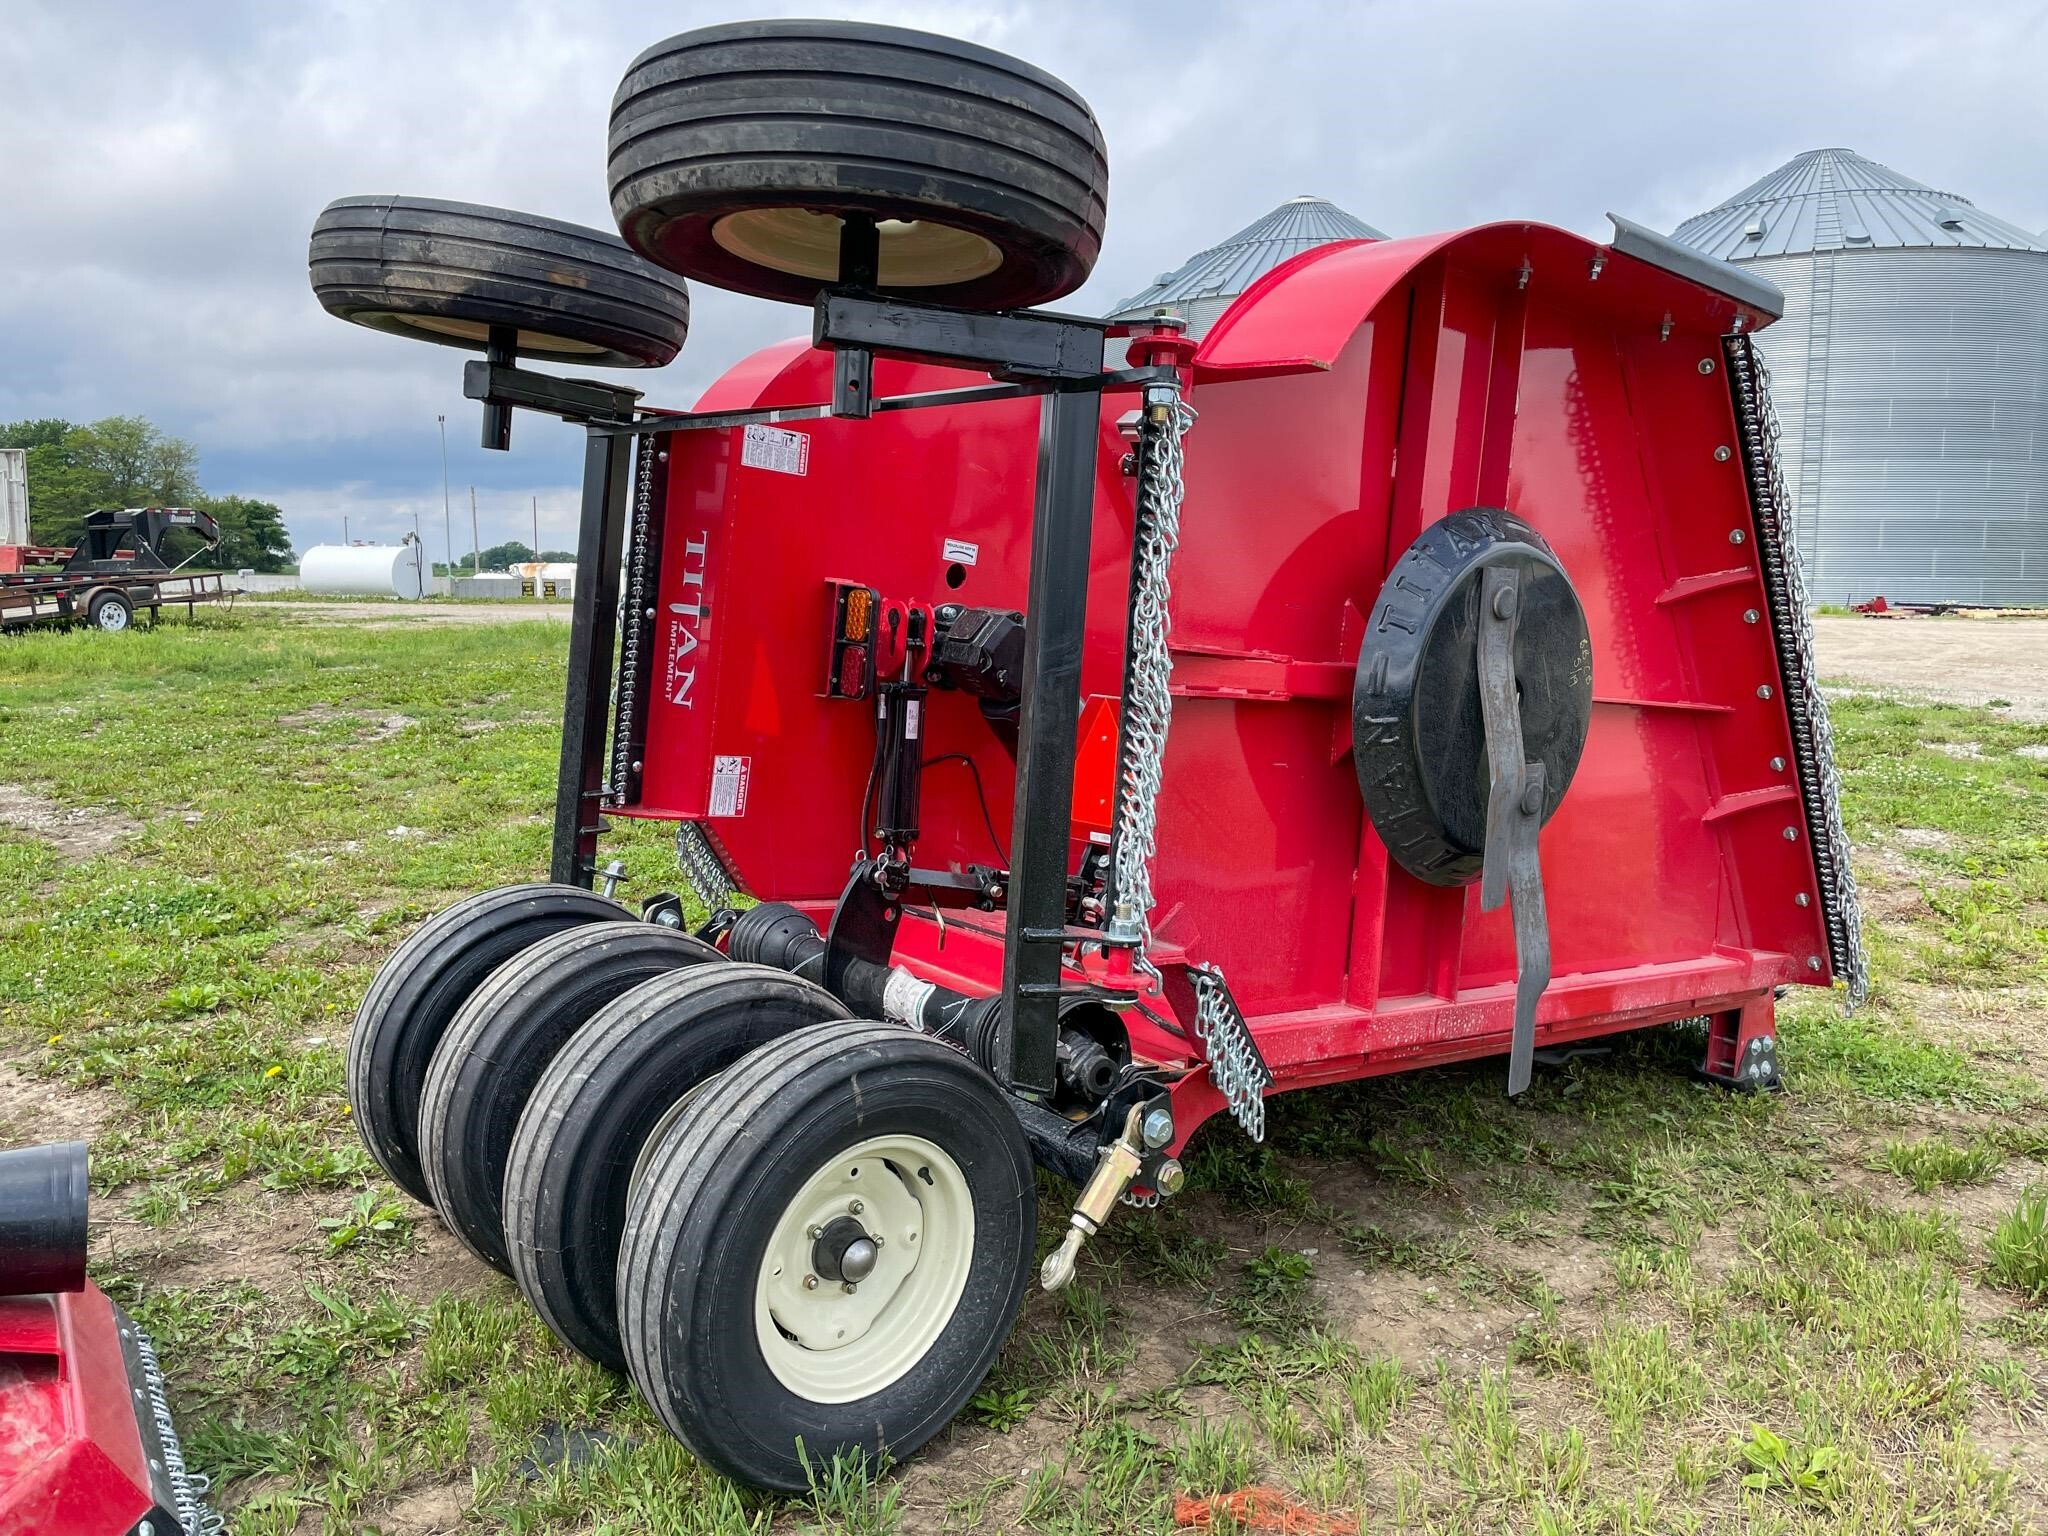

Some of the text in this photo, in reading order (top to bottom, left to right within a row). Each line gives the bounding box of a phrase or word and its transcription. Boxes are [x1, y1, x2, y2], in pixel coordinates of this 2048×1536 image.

[799, 443, 807, 473] DANGER
[668, 530, 710, 710] TITAN
[664, 620, 678, 701] IMPLEMENT
[736, 774, 747, 810] DANGER
